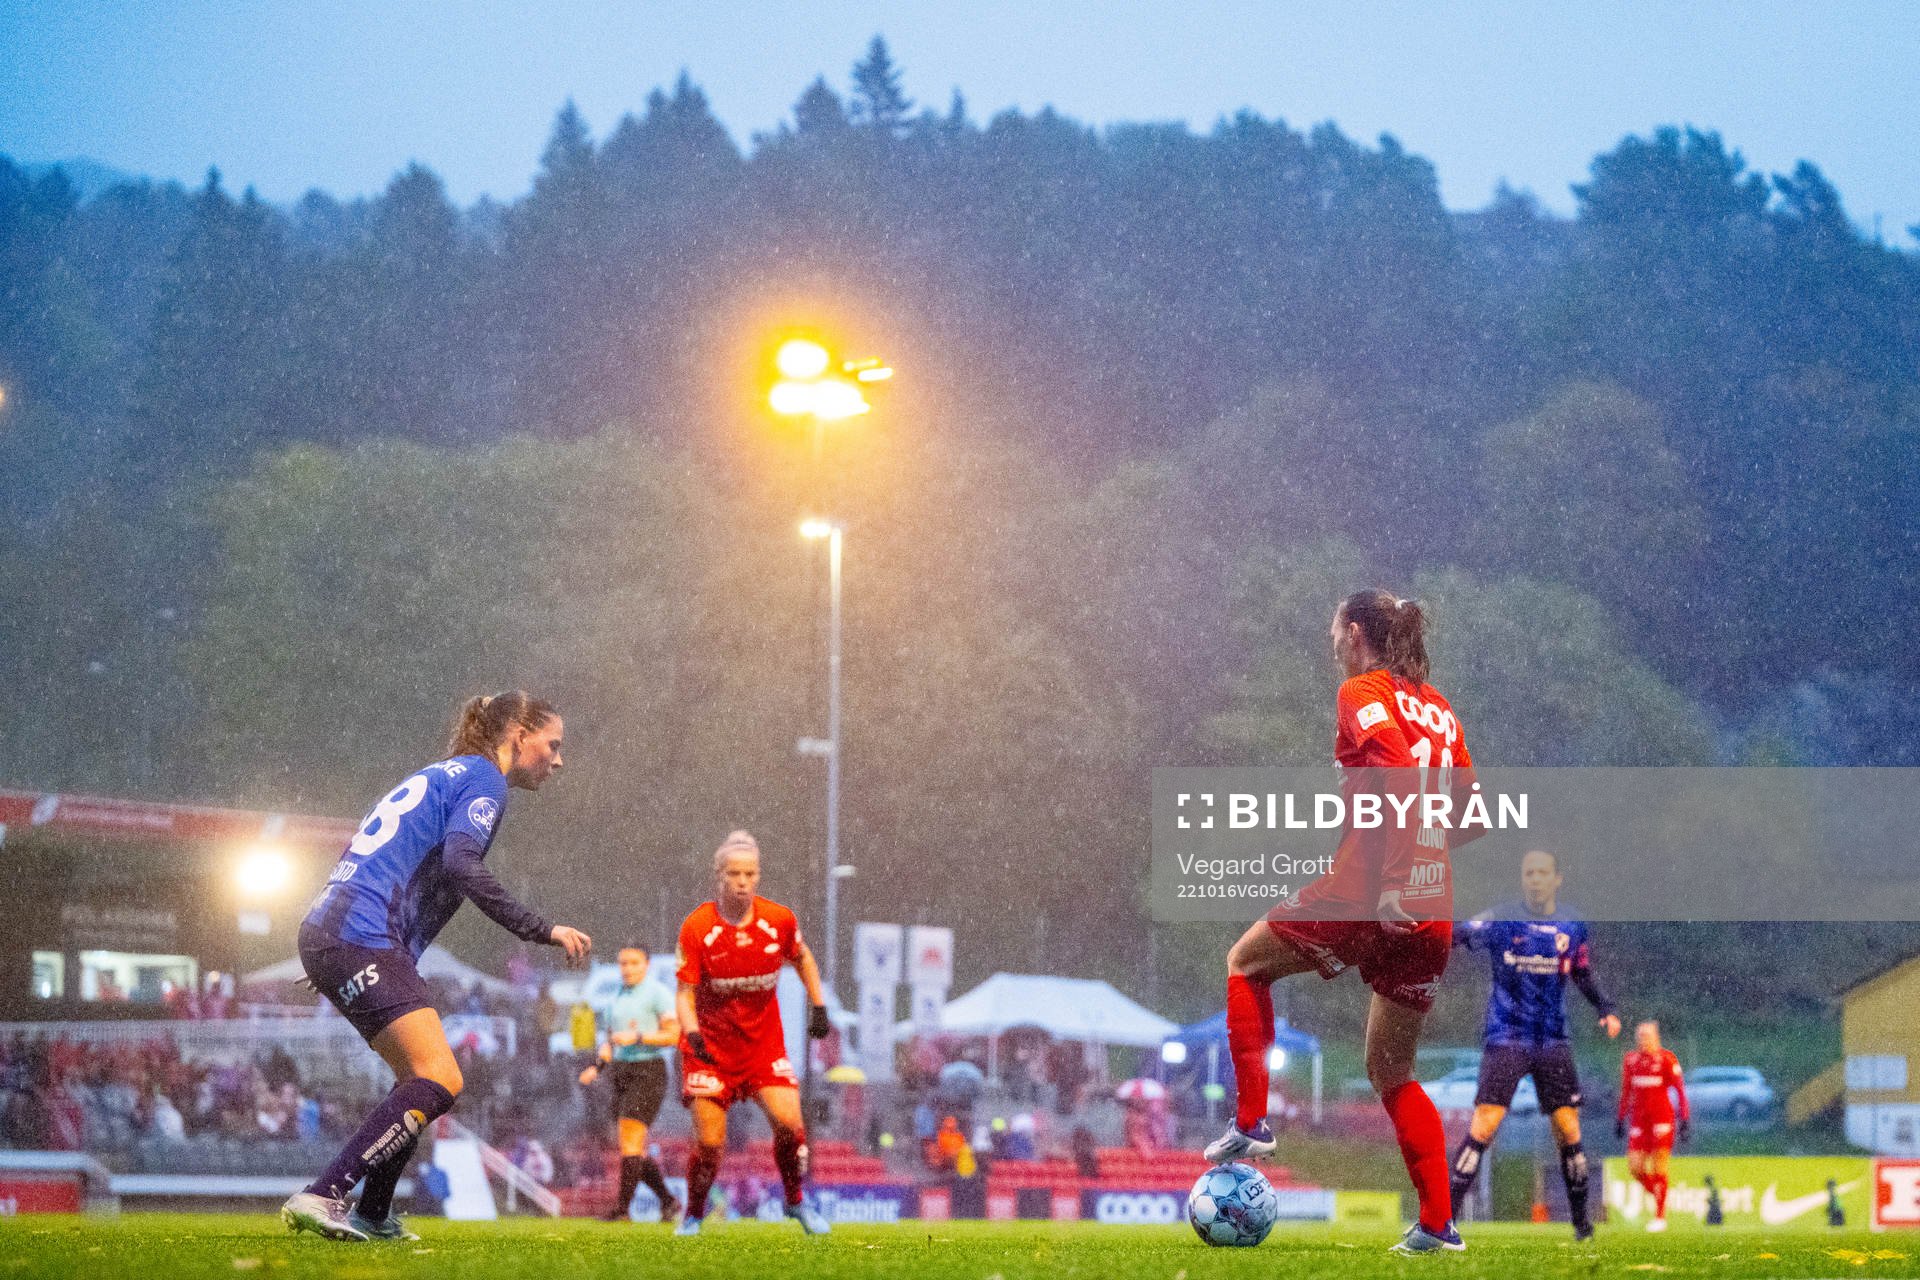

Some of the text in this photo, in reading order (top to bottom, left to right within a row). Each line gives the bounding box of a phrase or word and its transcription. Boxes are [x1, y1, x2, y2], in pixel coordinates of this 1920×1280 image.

[349, 775, 428, 856] 8
[1410, 863, 1445, 885] MOT
[338, 963, 380, 1006] SATS
